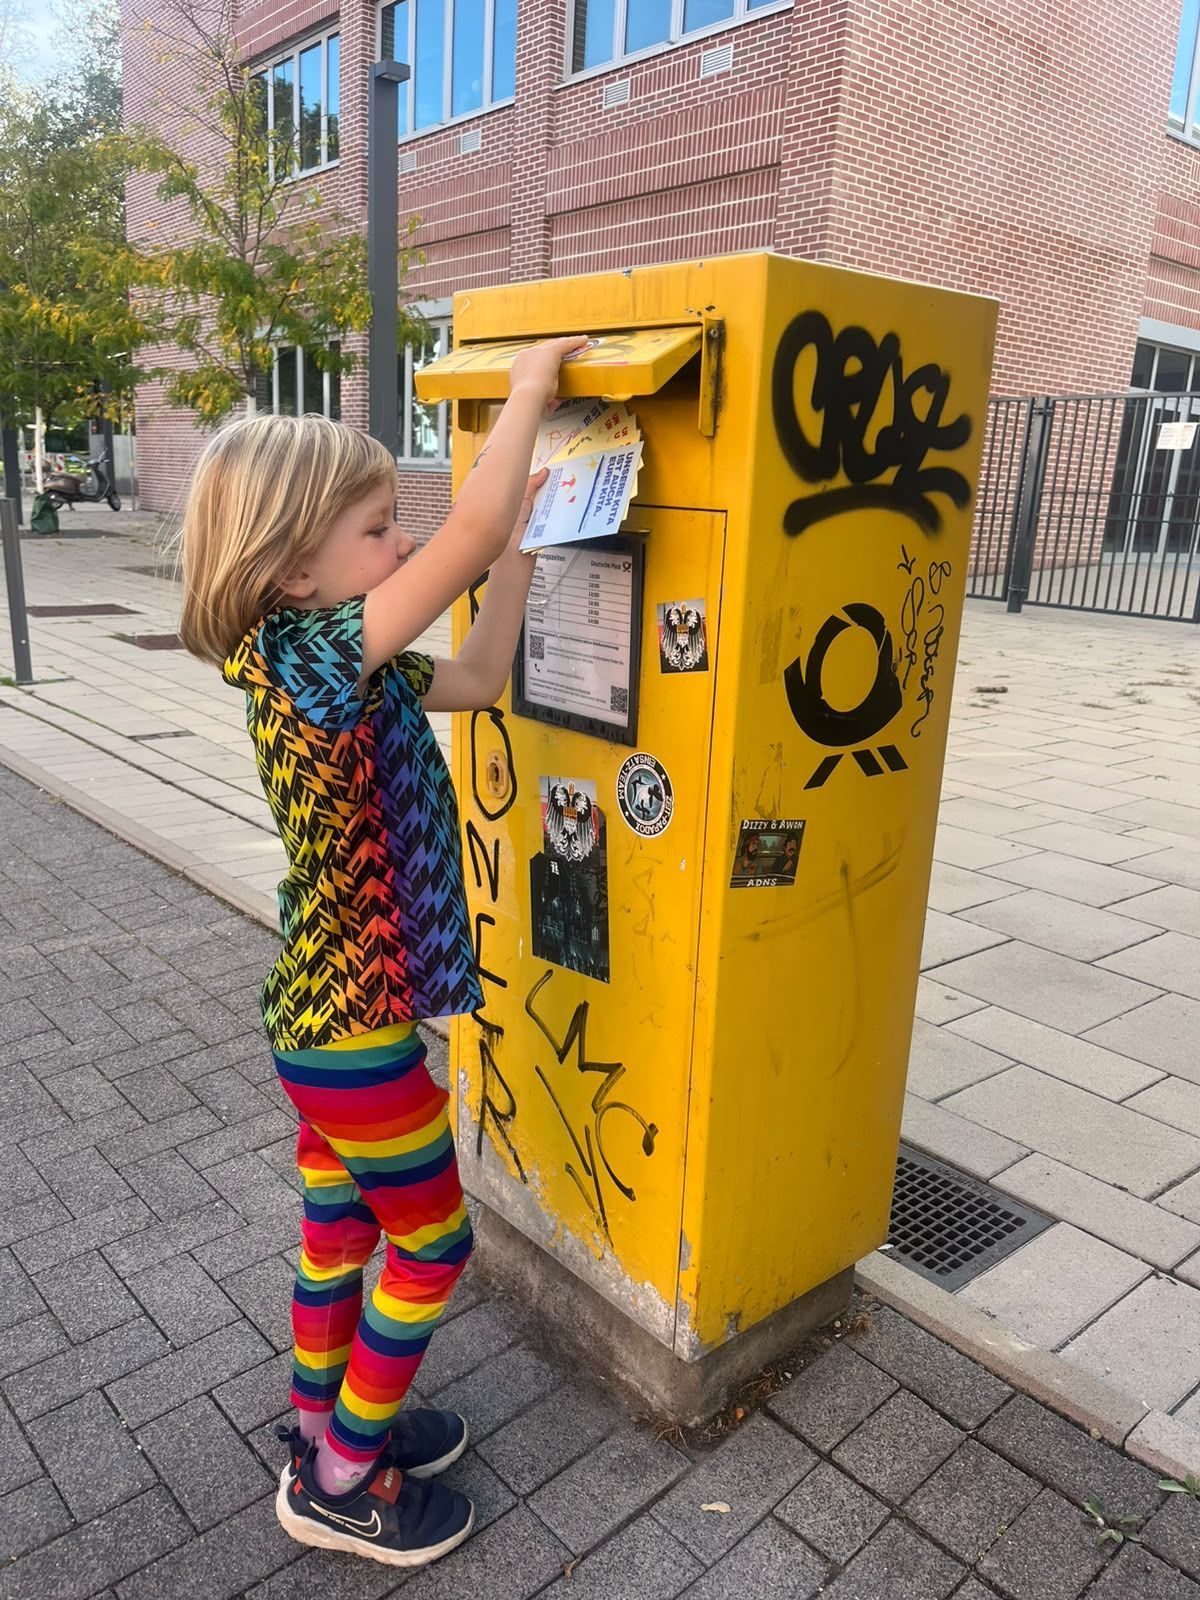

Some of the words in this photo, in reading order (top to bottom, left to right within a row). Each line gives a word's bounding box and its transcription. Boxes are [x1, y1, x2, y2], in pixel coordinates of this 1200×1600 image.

[603, 456, 616, 486] EURE
[615, 454, 625, 471] IST
[616, 452, 634, 498] UNSERE
[593, 487, 608, 517] KITA.
[605, 474, 619, 506] AUCH
[607, 499, 620, 526] KITA
[590, 560, 610, 569] Deutsche
[611, 562, 622, 570] Post
[742, 819, 768, 830] DIZZY
[770, 819, 778, 830] &
[746, 878, 778, 888] ADNS
